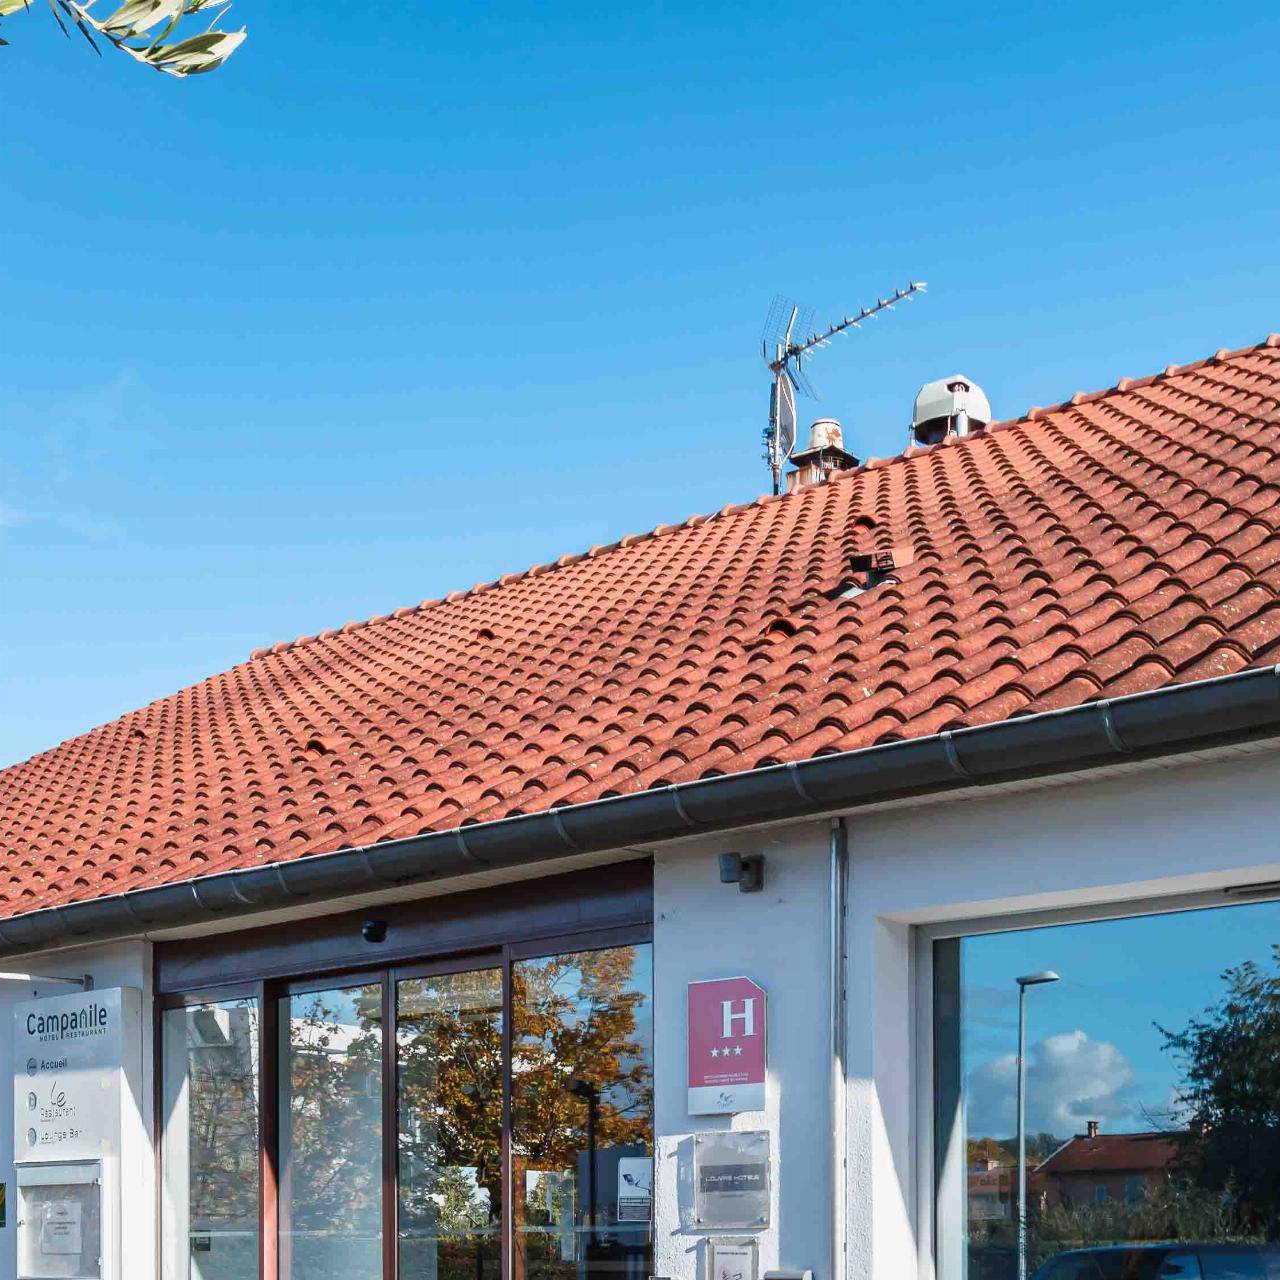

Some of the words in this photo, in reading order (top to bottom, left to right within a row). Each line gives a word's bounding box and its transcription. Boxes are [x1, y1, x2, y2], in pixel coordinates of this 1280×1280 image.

[27, 1003, 107, 1040] Campanile
[720, 998, 758, 1039] H
[65, 1028, 107, 1040] RESTAURANT
[41, 1058, 68, 1070] Accueil
[51, 1080, 66, 1107] Le
[41, 1106, 76, 1118] Restaurant
